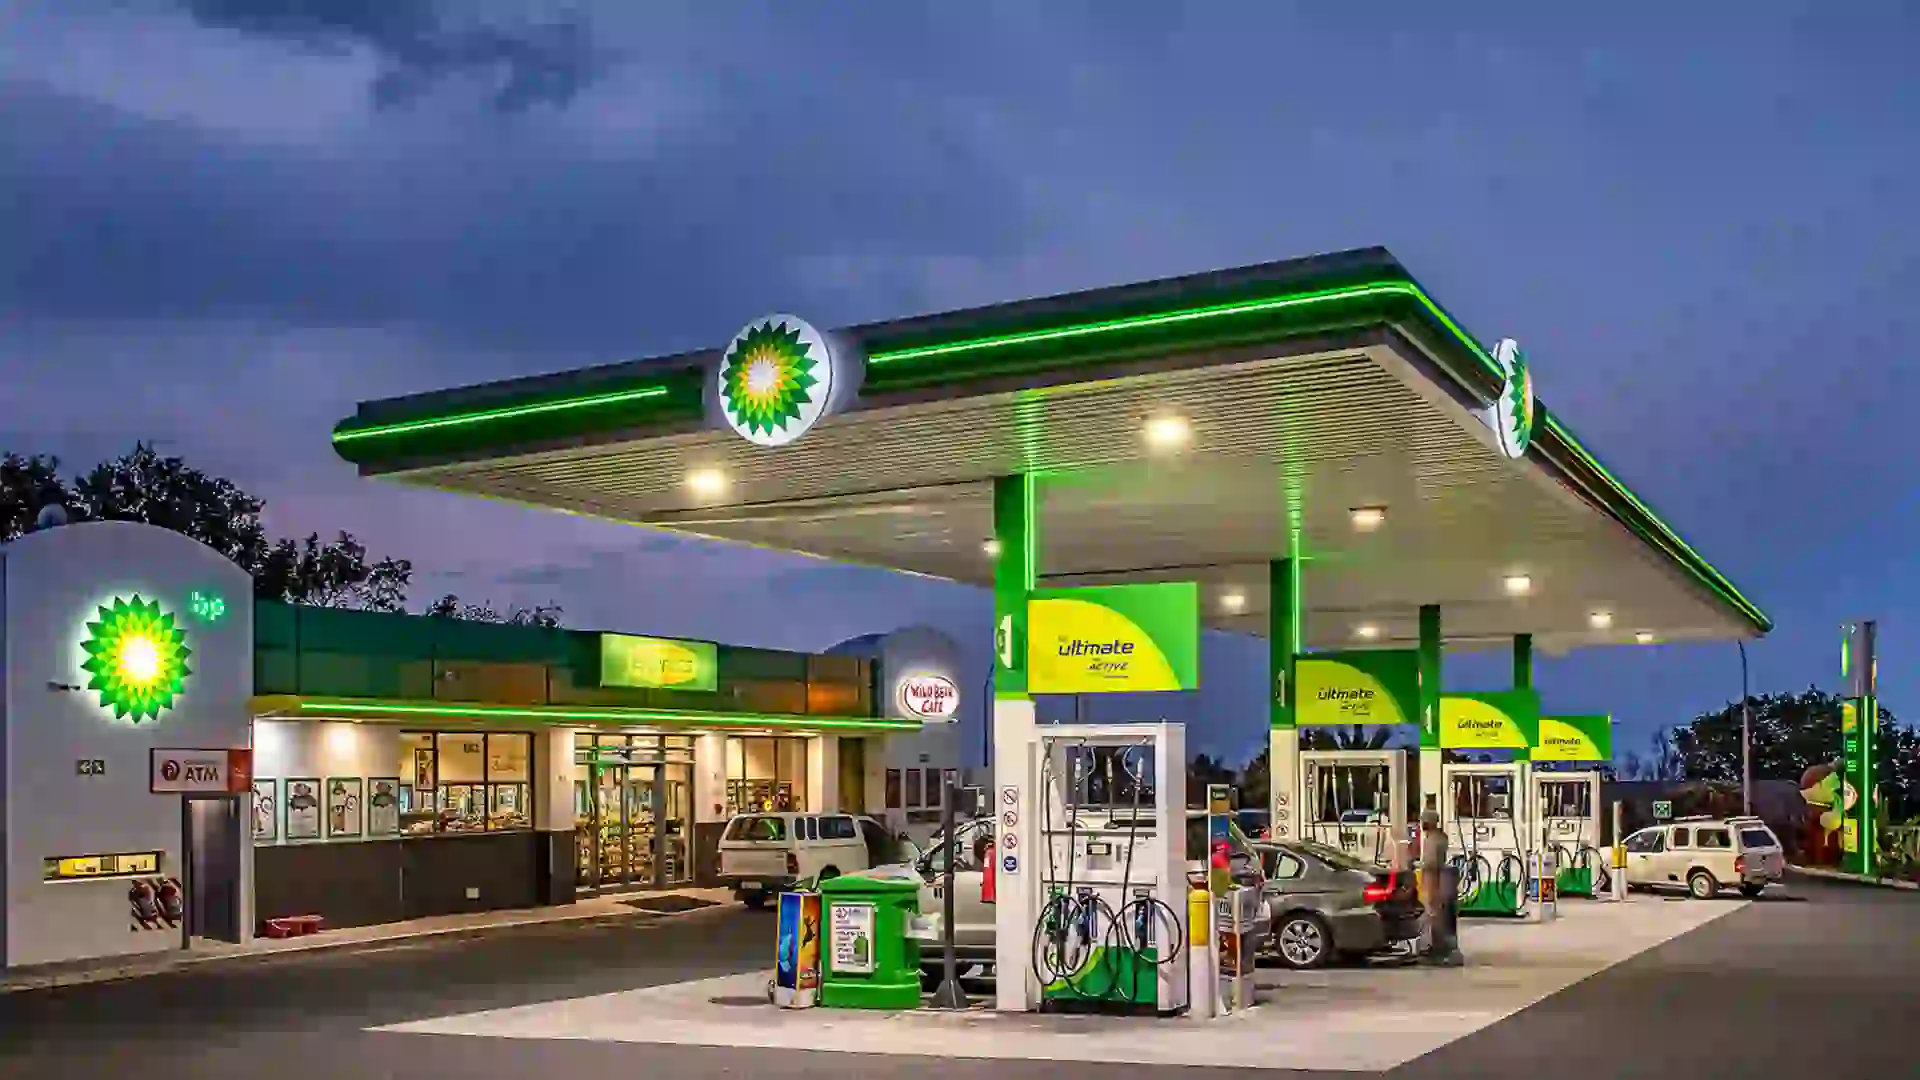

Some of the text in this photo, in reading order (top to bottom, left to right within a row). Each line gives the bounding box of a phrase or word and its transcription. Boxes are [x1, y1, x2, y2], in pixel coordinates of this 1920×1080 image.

[191, 591, 225, 621] bp
[1059, 639, 1135, 656] ultimate
[185, 766, 219, 781] ATM
